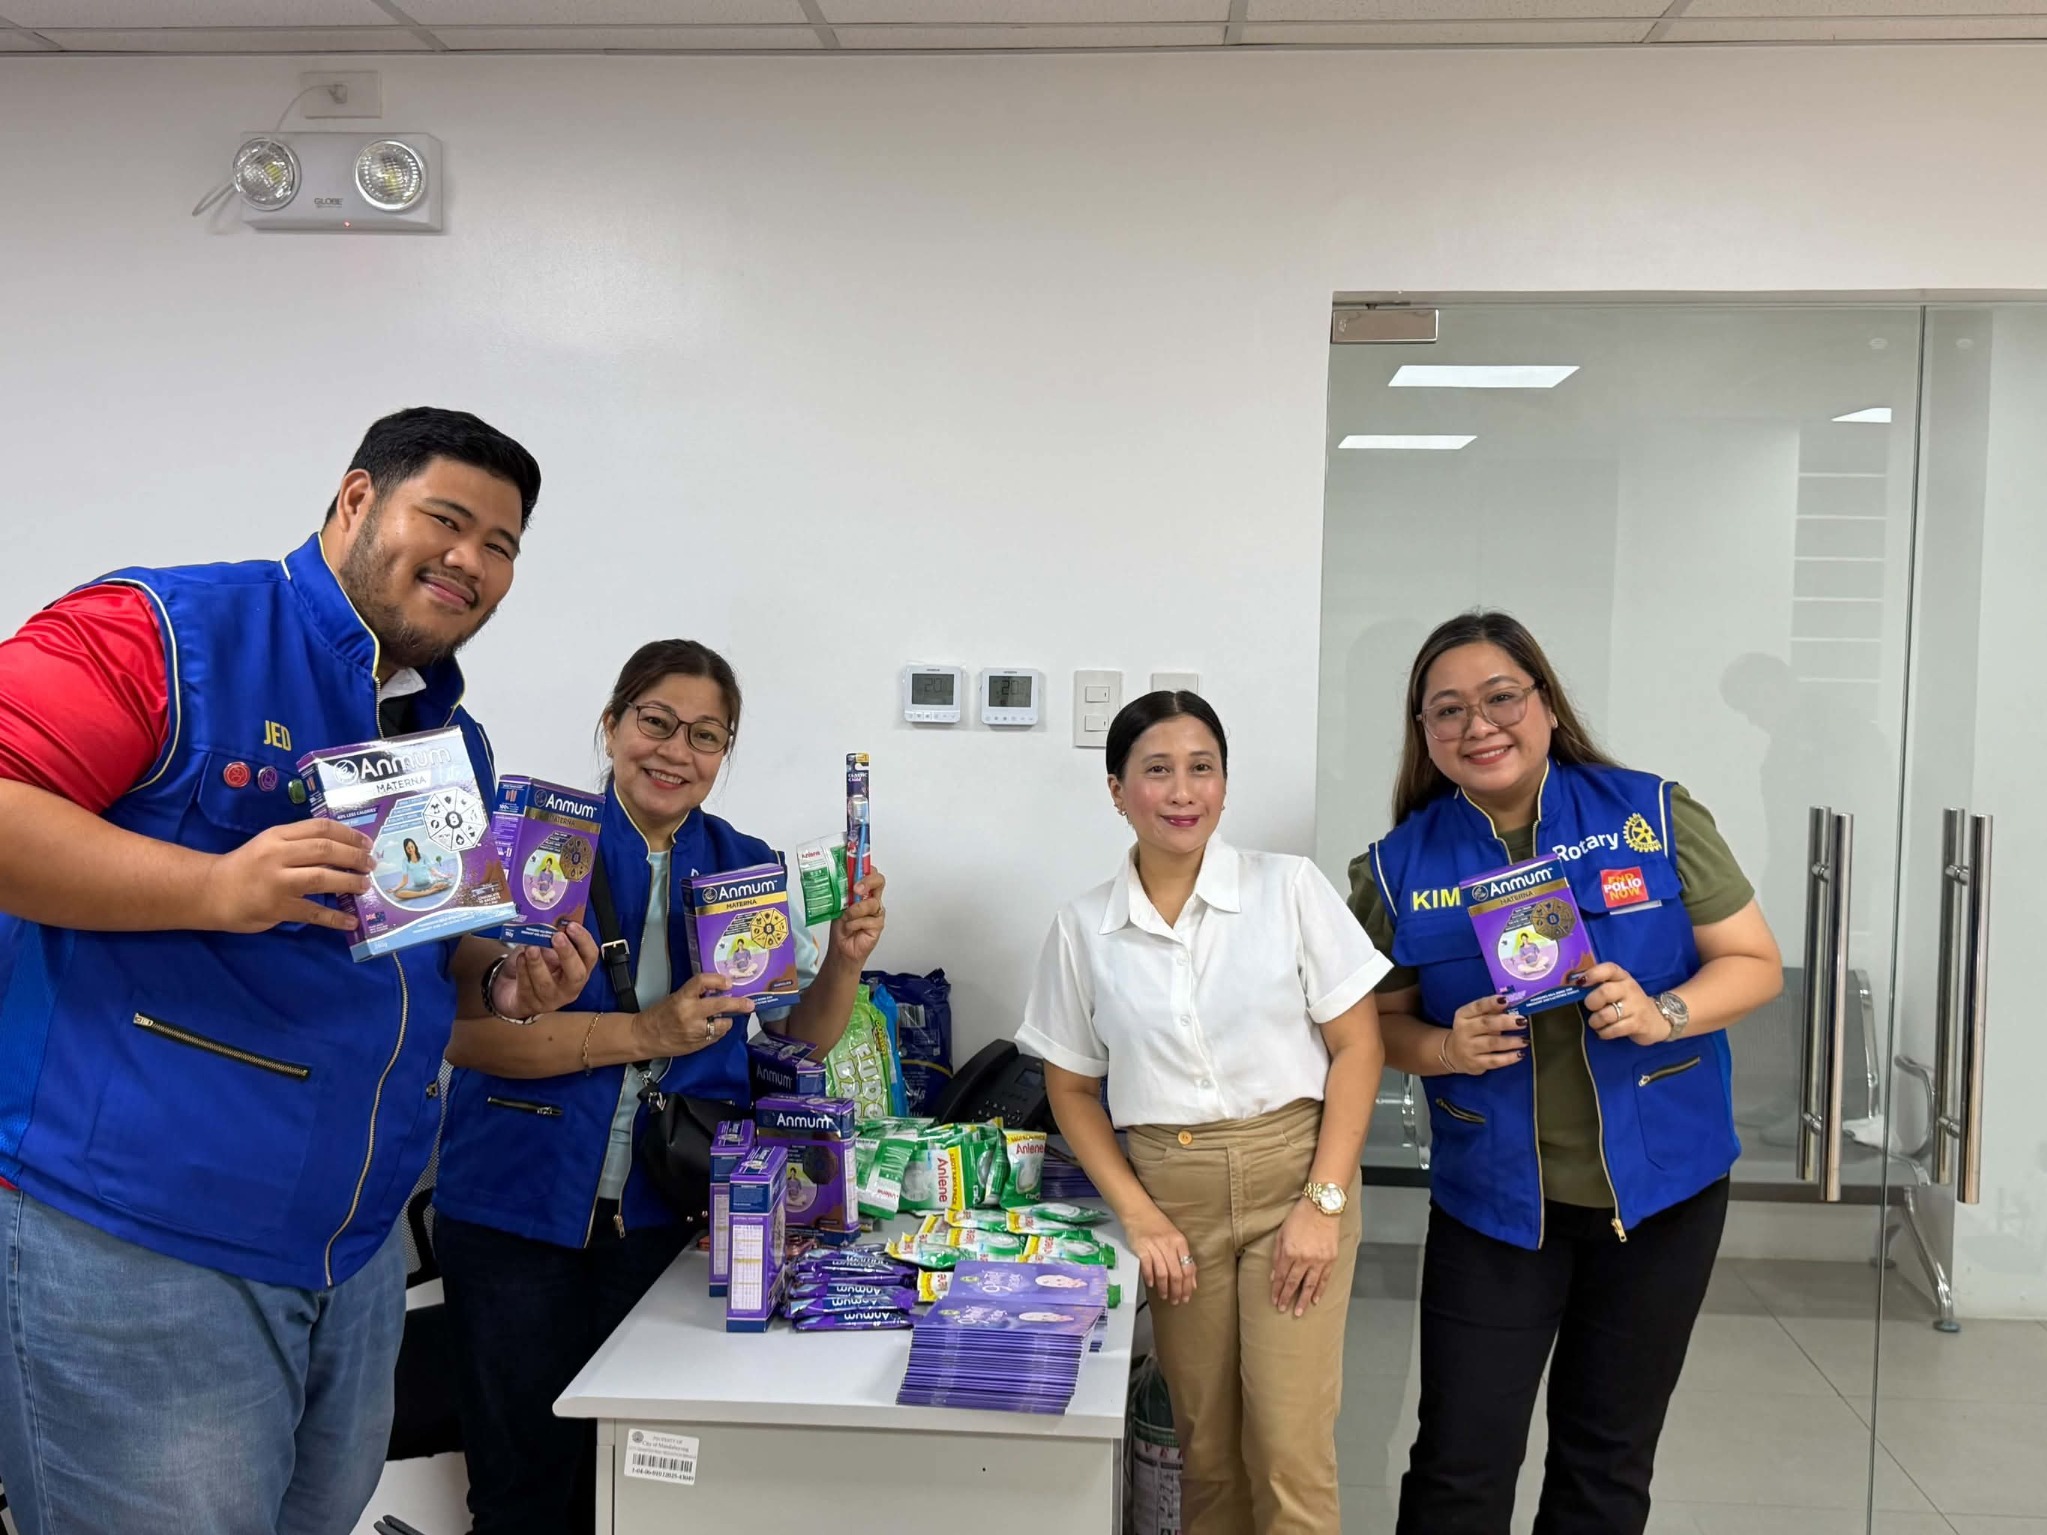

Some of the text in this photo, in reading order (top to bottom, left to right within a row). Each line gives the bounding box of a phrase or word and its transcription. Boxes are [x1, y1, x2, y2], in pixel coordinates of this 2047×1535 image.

[314, 197, 343, 206] GLOBE
[263, 719, 292, 752] JED
[361, 747, 451, 780] Anmum
[376, 775, 427, 794] MATERNA
[545, 793, 595, 818] Anmum
[1552, 831, 1618, 862] Rotary
[1489, 868, 1550, 897] Anmum
[1603, 878, 1642, 893] POLIO
[1607, 872, 1635, 886] END
[718, 880, 775, 901] Anmum
[1412, 887, 1462, 912] KIM
[1500, 890, 1534, 905] MATERNA
[1609, 887, 1640, 901] NOW
[726, 899, 758, 910] MATERNA
[756, 1064, 792, 1090] Anmum
[776, 1112, 831, 1130] Anmum
[1015, 1143, 1044, 1155] Anlene
[937, 1157, 948, 1203] Anlene
[836, 1285, 881, 1296] Anmum
[844, 1311, 890, 1322] Anmum
